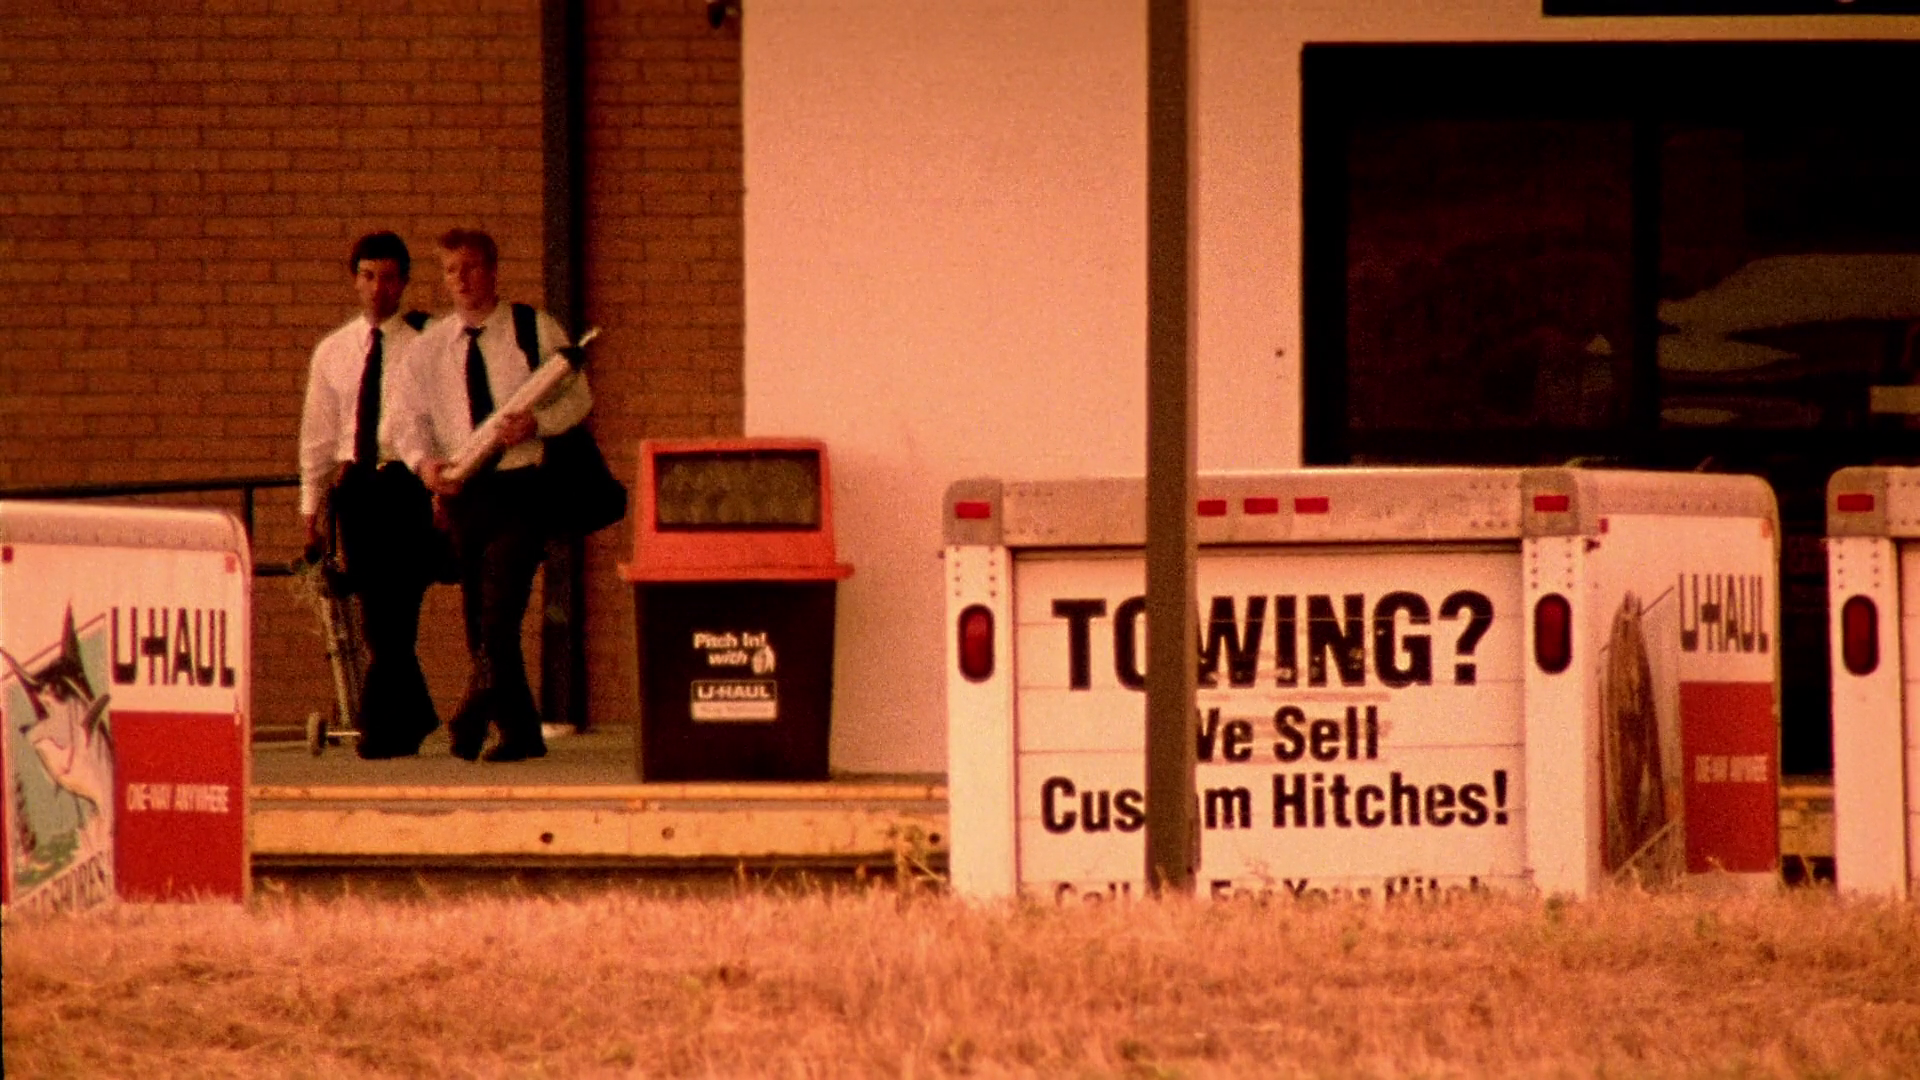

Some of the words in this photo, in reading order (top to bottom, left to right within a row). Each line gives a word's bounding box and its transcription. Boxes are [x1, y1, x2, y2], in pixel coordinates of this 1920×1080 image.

[694, 632, 738, 649] Pitch
[1051, 589, 1494, 690] TOWING?
[1679, 573, 1768, 654] U-HAUL
[111, 606, 235, 688] U-HAUL
[698, 686, 770, 699] U-HAUL
[1273, 705, 1379, 762] Sell
[1041, 775, 1252, 835] Cusm
[1272, 769, 1508, 829] Hitches!
